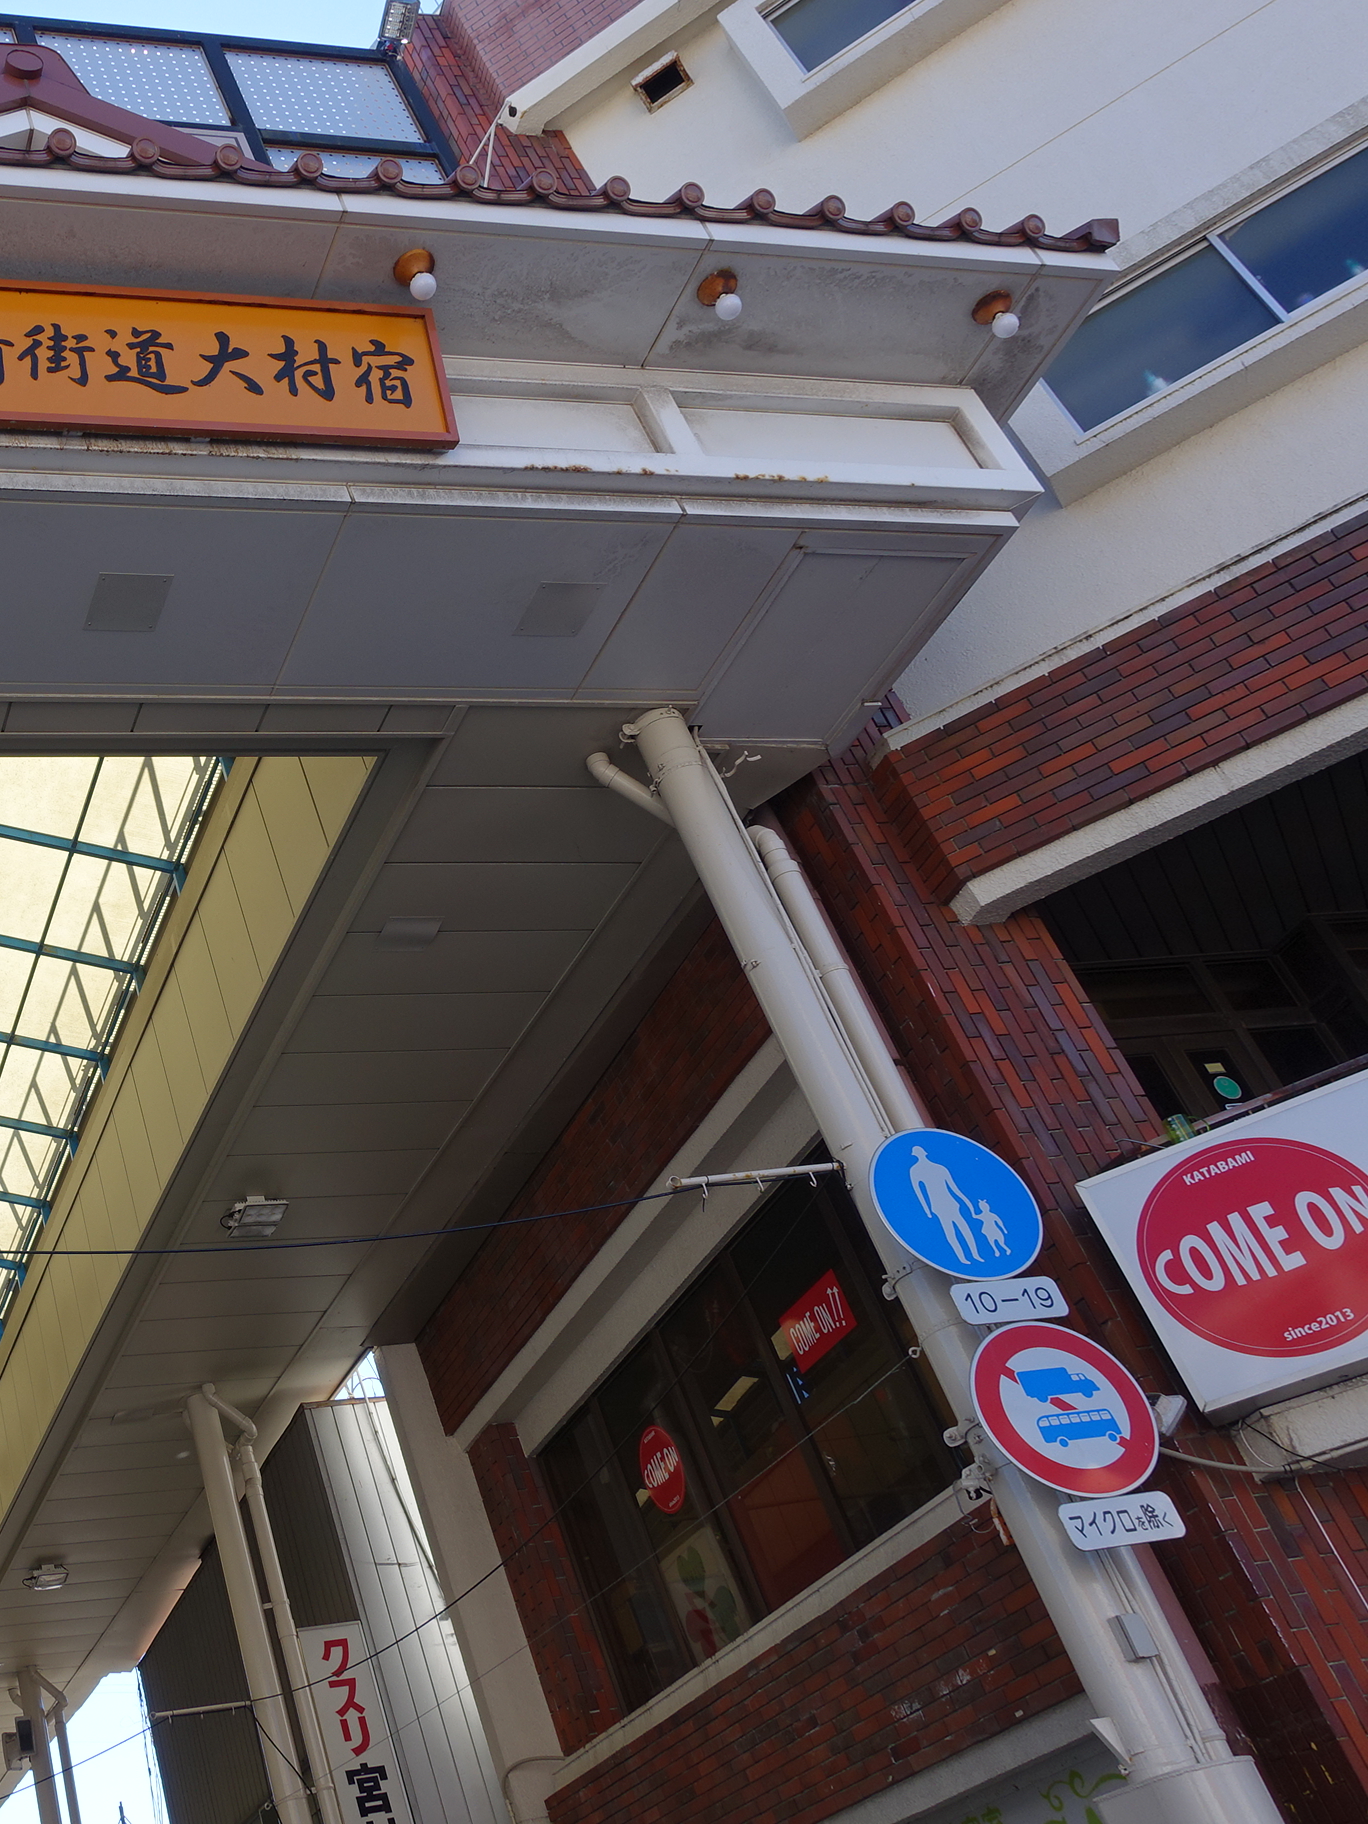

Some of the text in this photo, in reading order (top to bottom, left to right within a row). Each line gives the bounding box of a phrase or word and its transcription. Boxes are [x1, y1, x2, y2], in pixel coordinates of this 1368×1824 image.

[1182, 1150, 1255, 1186] KATABAMI
[1155, 1185, 1368, 1294] COME ON
[789, 1311, 820, 1355] COME
[1283, 1307, 1355, 1341] since2013
[644, 1446, 679, 1488] COME ON
[1068, 1503, 1174, 1538] マイクロを除く
